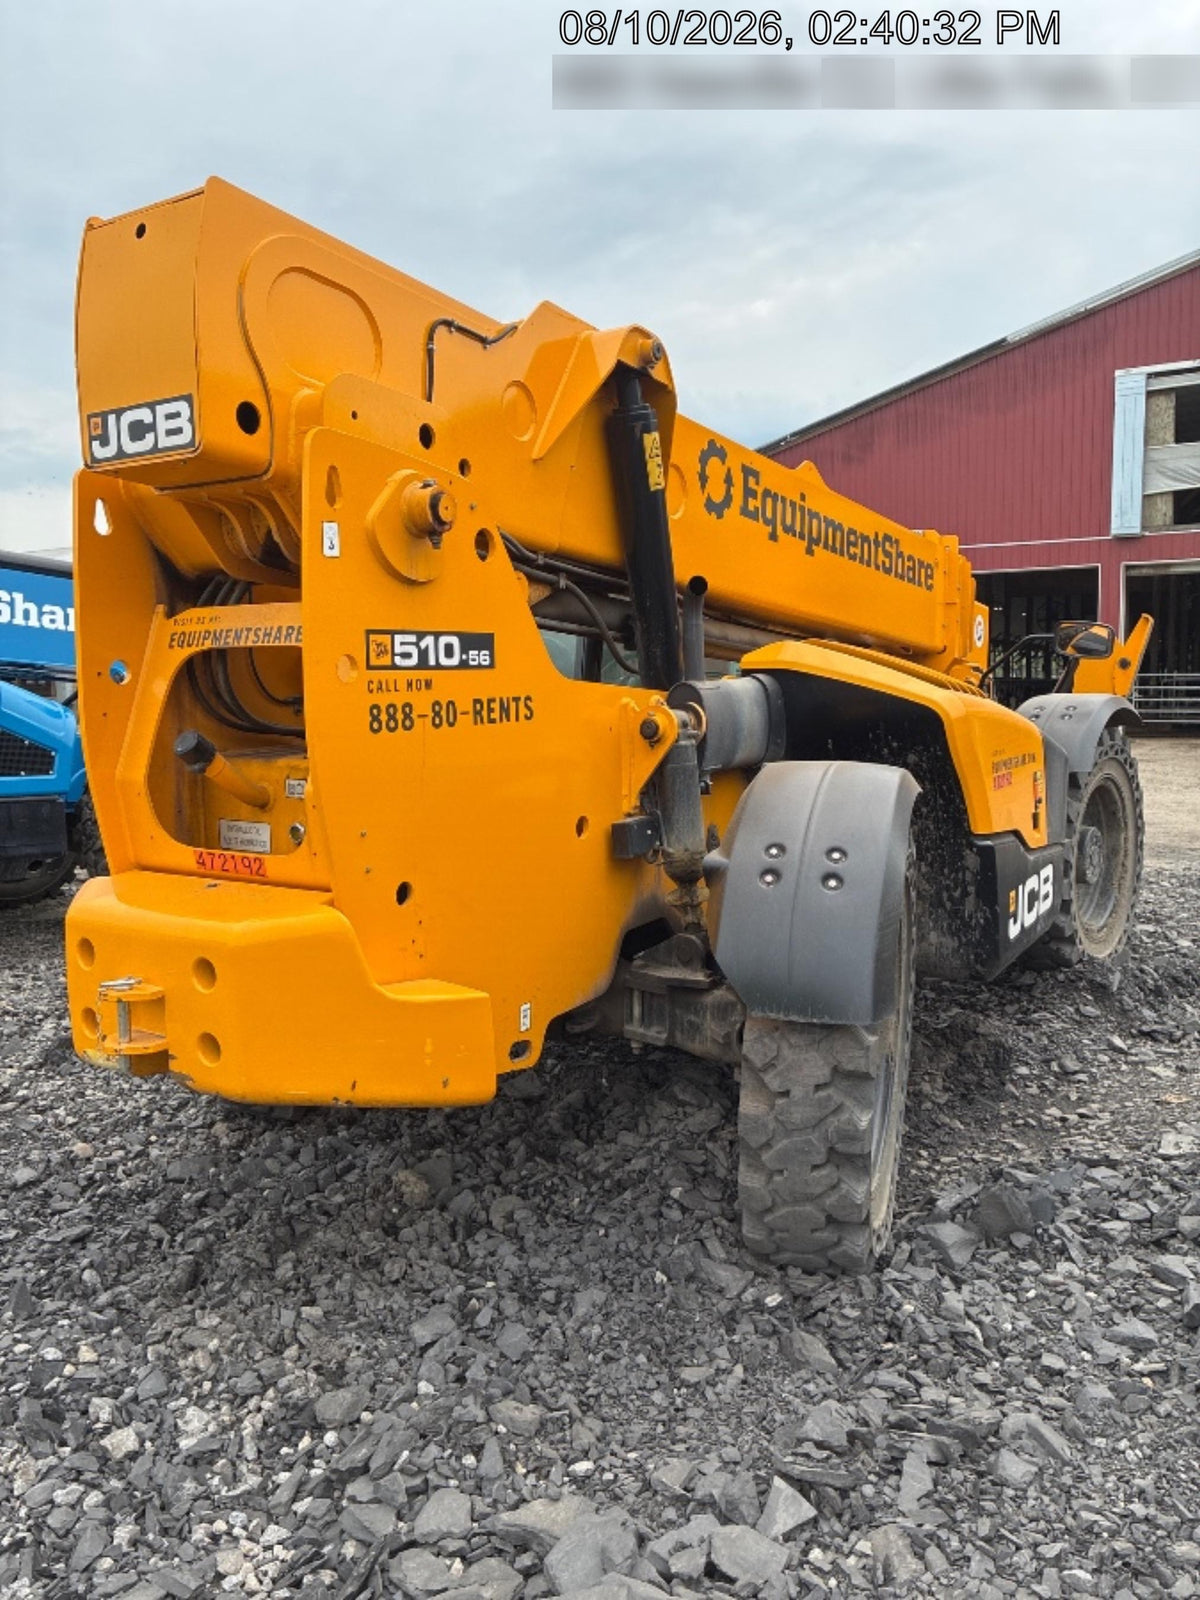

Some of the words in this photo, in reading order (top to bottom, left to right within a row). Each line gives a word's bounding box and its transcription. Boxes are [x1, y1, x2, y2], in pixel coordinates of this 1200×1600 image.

[91, 400, 193, 460] JCB
[739, 462, 935, 593] EquipmentShare
[168, 625, 303, 650] EQUIPMENTSHARE
[367, 678, 401, 694] CALL
[405, 678, 434, 692] NOW
[368, 694, 535, 735] 888-80-RENTS
[196, 851, 267, 878] 472192
[1007, 862, 1054, 940] JCB
